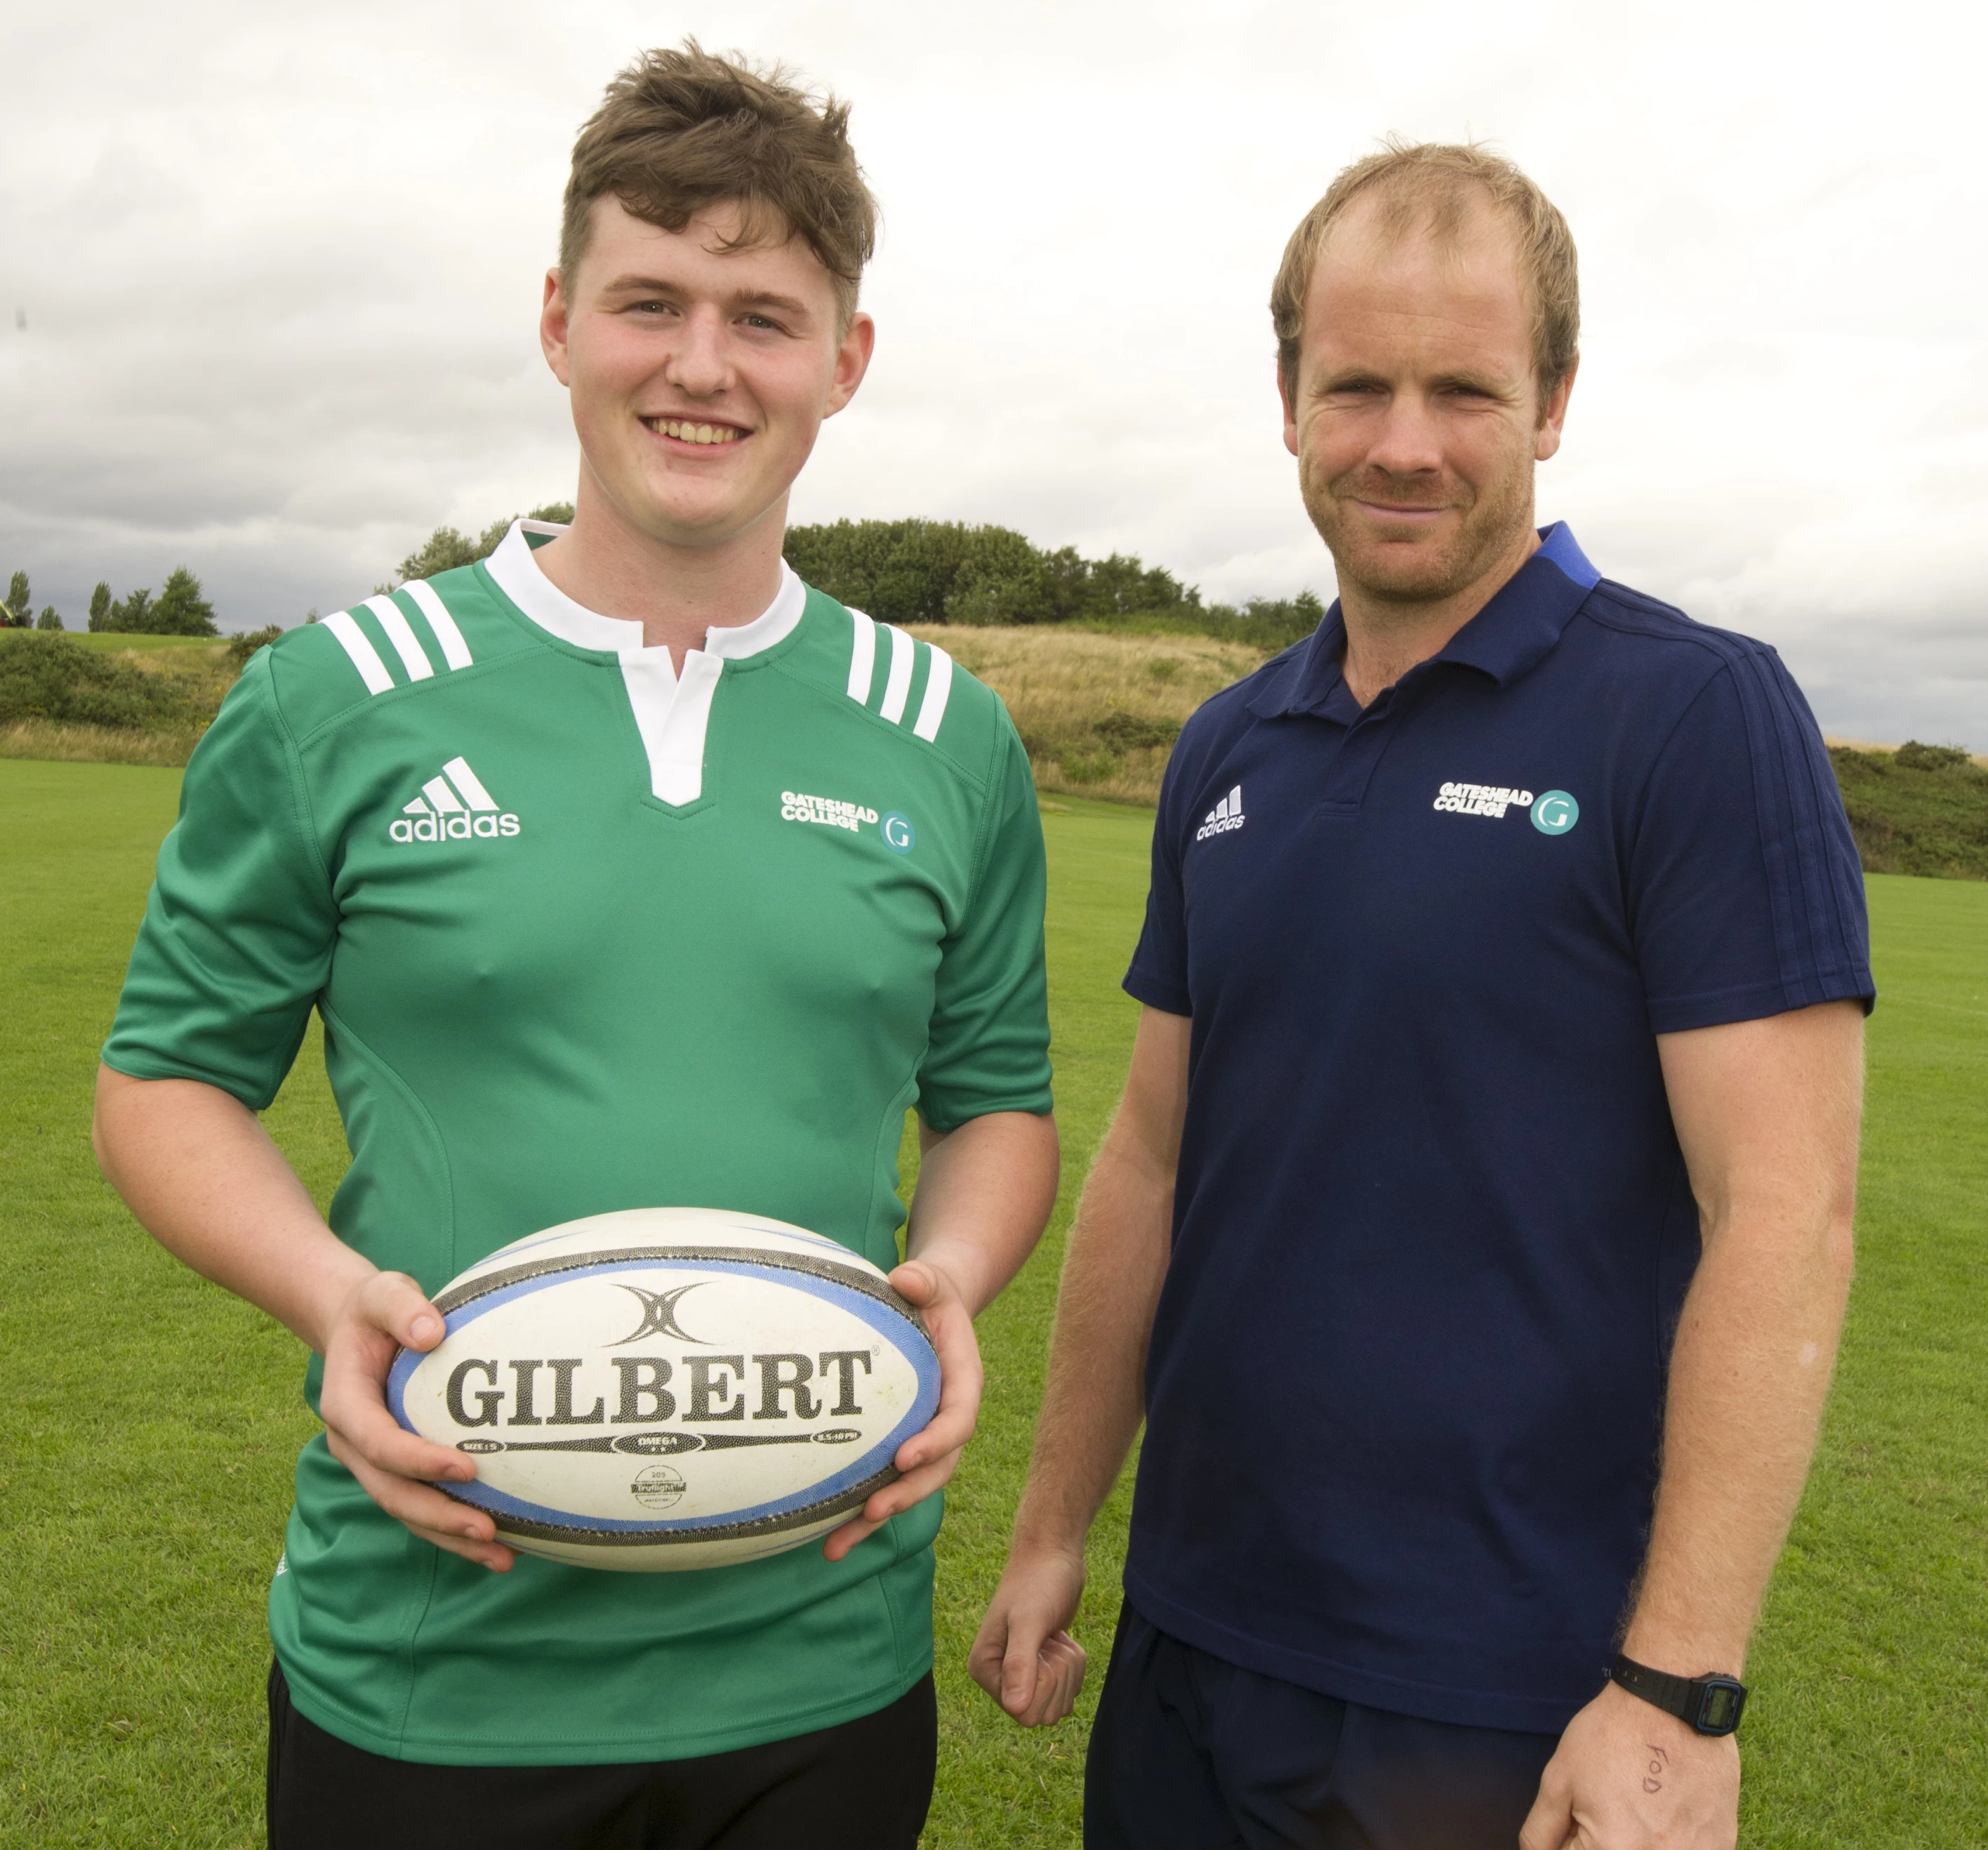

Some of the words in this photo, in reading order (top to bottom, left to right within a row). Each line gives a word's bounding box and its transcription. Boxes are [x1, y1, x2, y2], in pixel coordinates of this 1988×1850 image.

[781, 791, 879, 824] GATESHEAD
[1433, 795, 1509, 819] COLLEGE
[1438, 781, 1534, 807] GATESHEAD
[389, 809, 521, 843] adidas
[781, 805, 859, 833] COLLEGE
[1196, 814, 1246, 842] adidas
[446, 1350, 872, 1427] GILBERT
[637, 1436, 677, 1446] OMEGA
